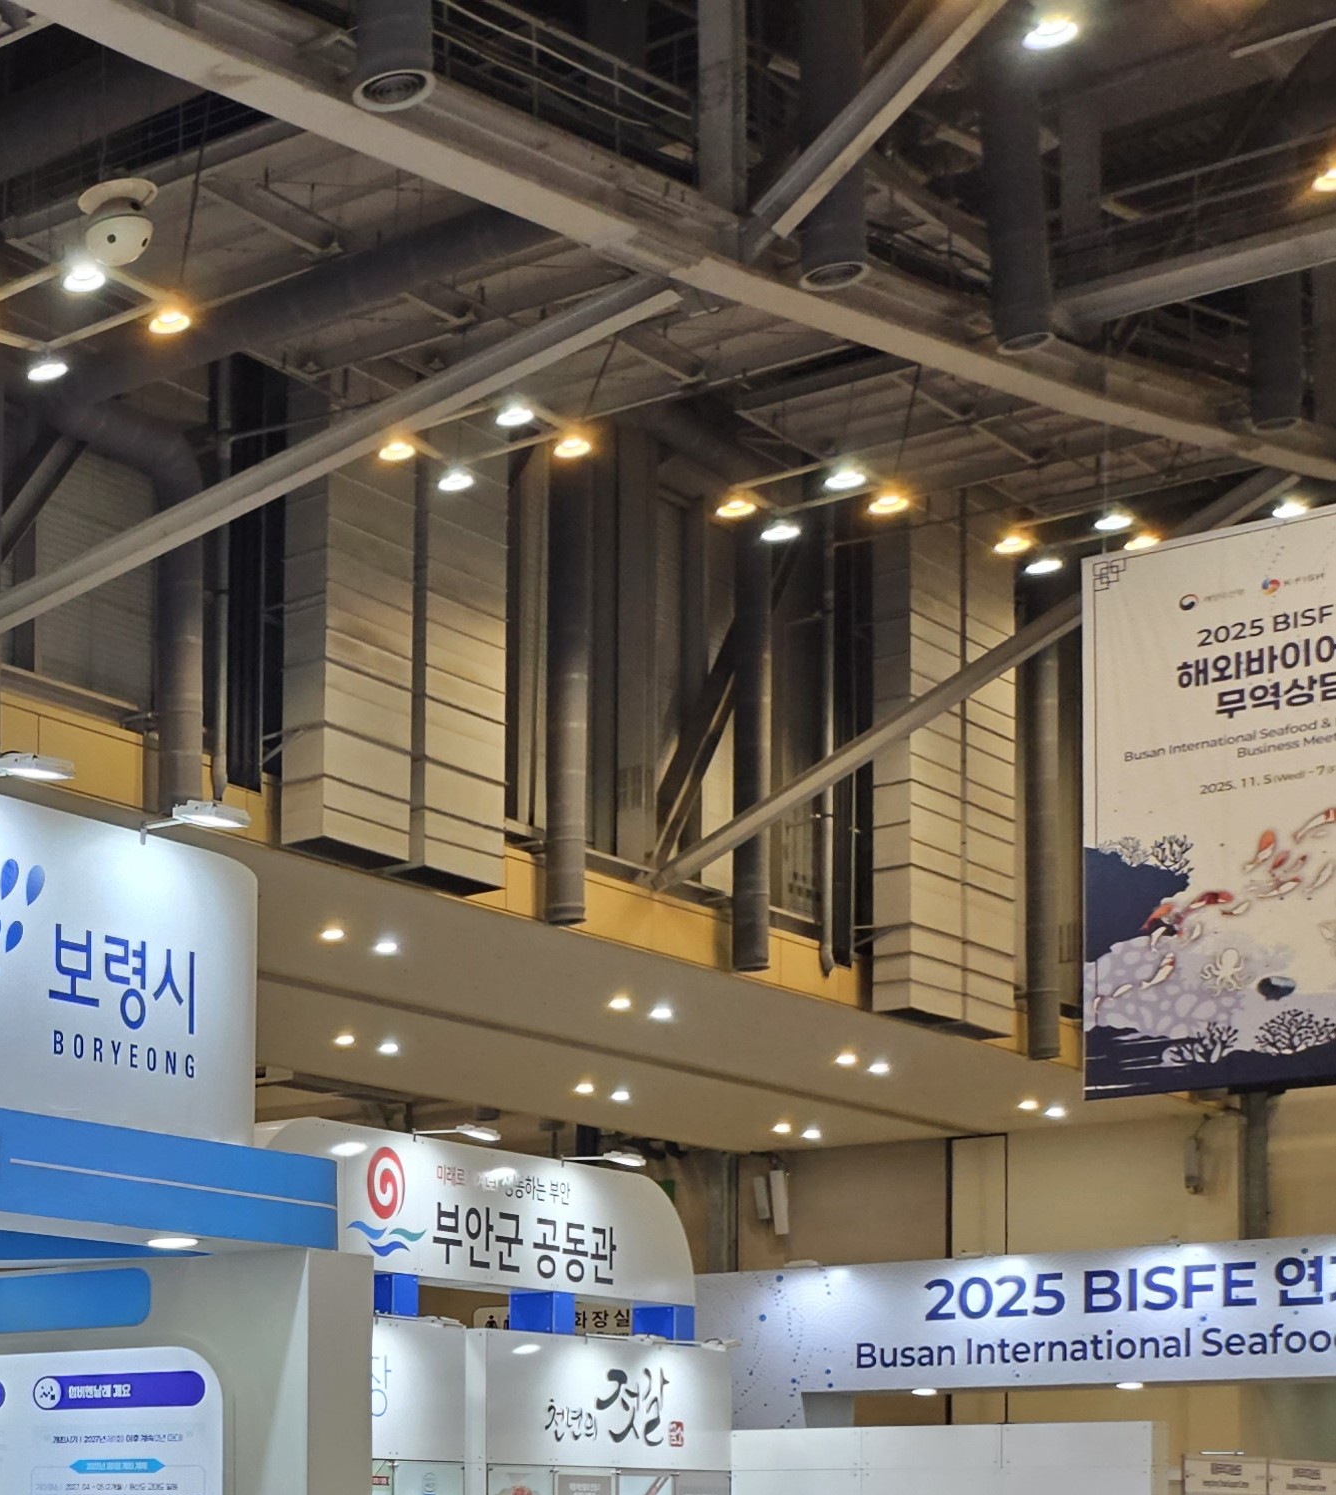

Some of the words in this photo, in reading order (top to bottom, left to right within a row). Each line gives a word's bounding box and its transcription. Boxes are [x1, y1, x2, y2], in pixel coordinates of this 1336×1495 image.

[1197, 618, 1264, 647] 2025
[1124, 747, 1166, 762] Busan
[1169, 730, 1257, 755] International
[1259, 720, 1317, 740] Seafood
[1321, 718, 1331, 729] &
[1237, 739, 1300, 758] Business
[48, 923, 195, 1035] 보령시
[53, 1029, 195, 1079] BORYEONG
[549, 1179, 571, 1205] 부안
[433, 1202, 523, 1273] 부안군
[533, 1217, 616, 1285] 공동관
[925, 1272, 1066, 1322] 2025
[1084, 1261, 1258, 1314] BISFE
[855, 1341, 955, 1370] Busan
[966, 1328, 1191, 1366] International
[1201, 1323, 1336, 1357] Seafoo
[596, 1367, 670, 1447] 젓갈
